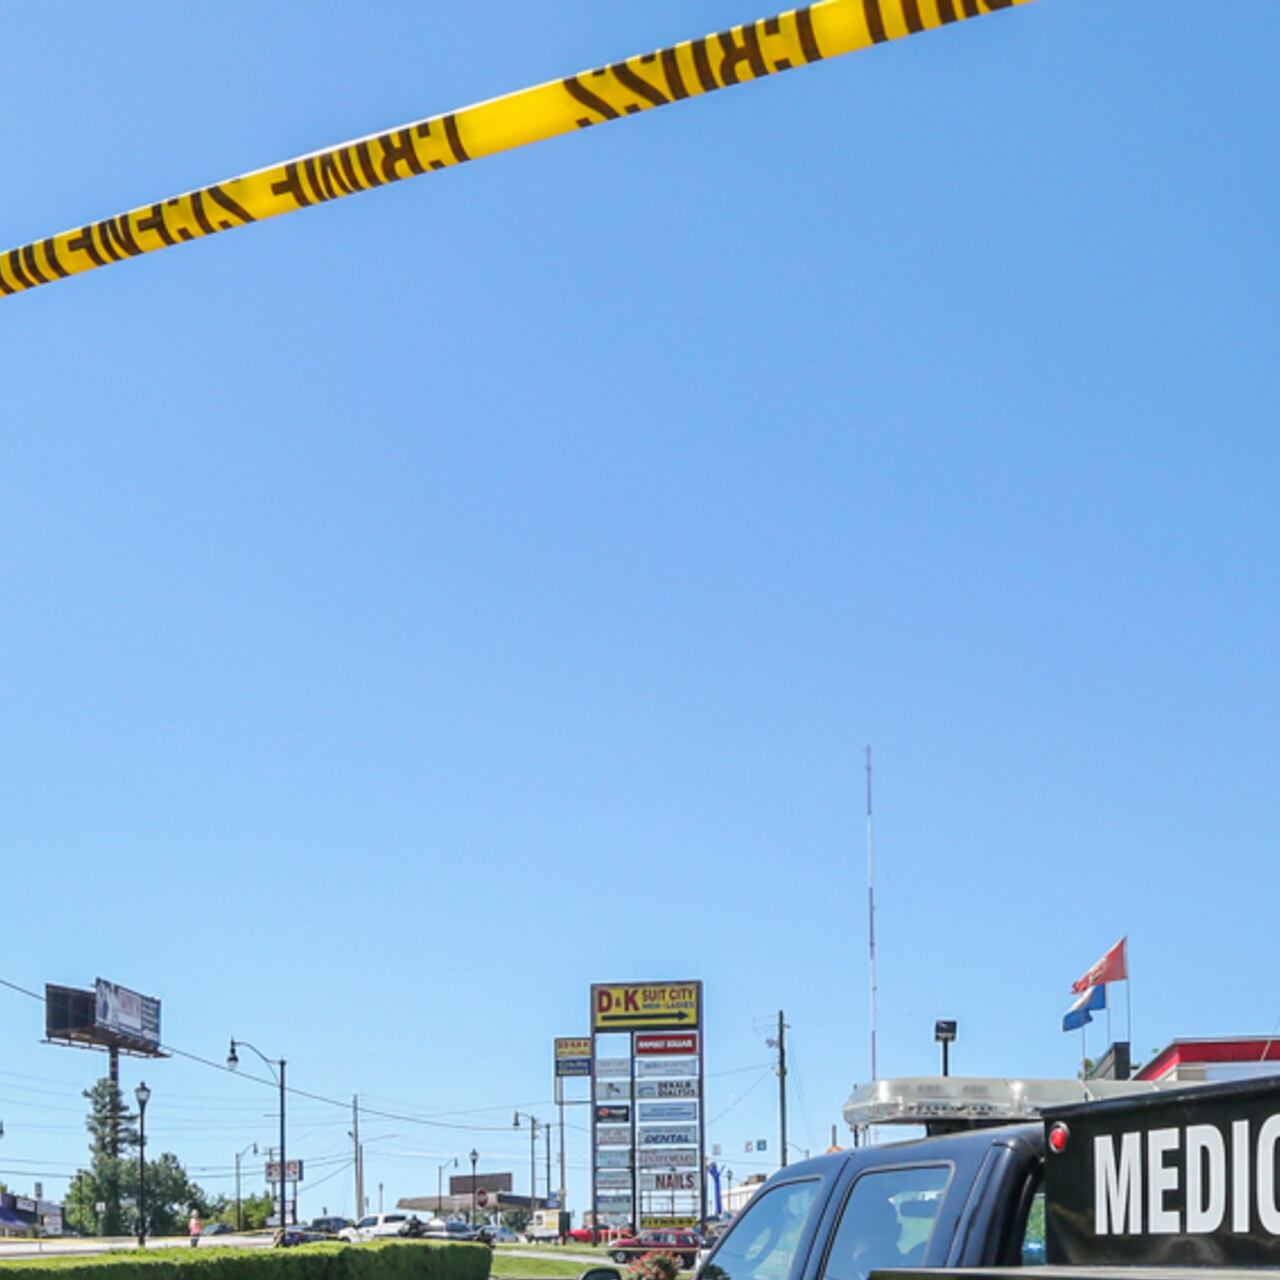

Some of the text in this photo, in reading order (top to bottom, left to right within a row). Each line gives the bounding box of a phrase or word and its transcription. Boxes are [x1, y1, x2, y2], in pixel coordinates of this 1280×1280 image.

[642, 989, 666, 1002] SUIT
[669, 988, 693, 1001] CITY
[644, 1135, 689, 1144] DENTAL
[655, 1173, 694, 1189] NAILS
